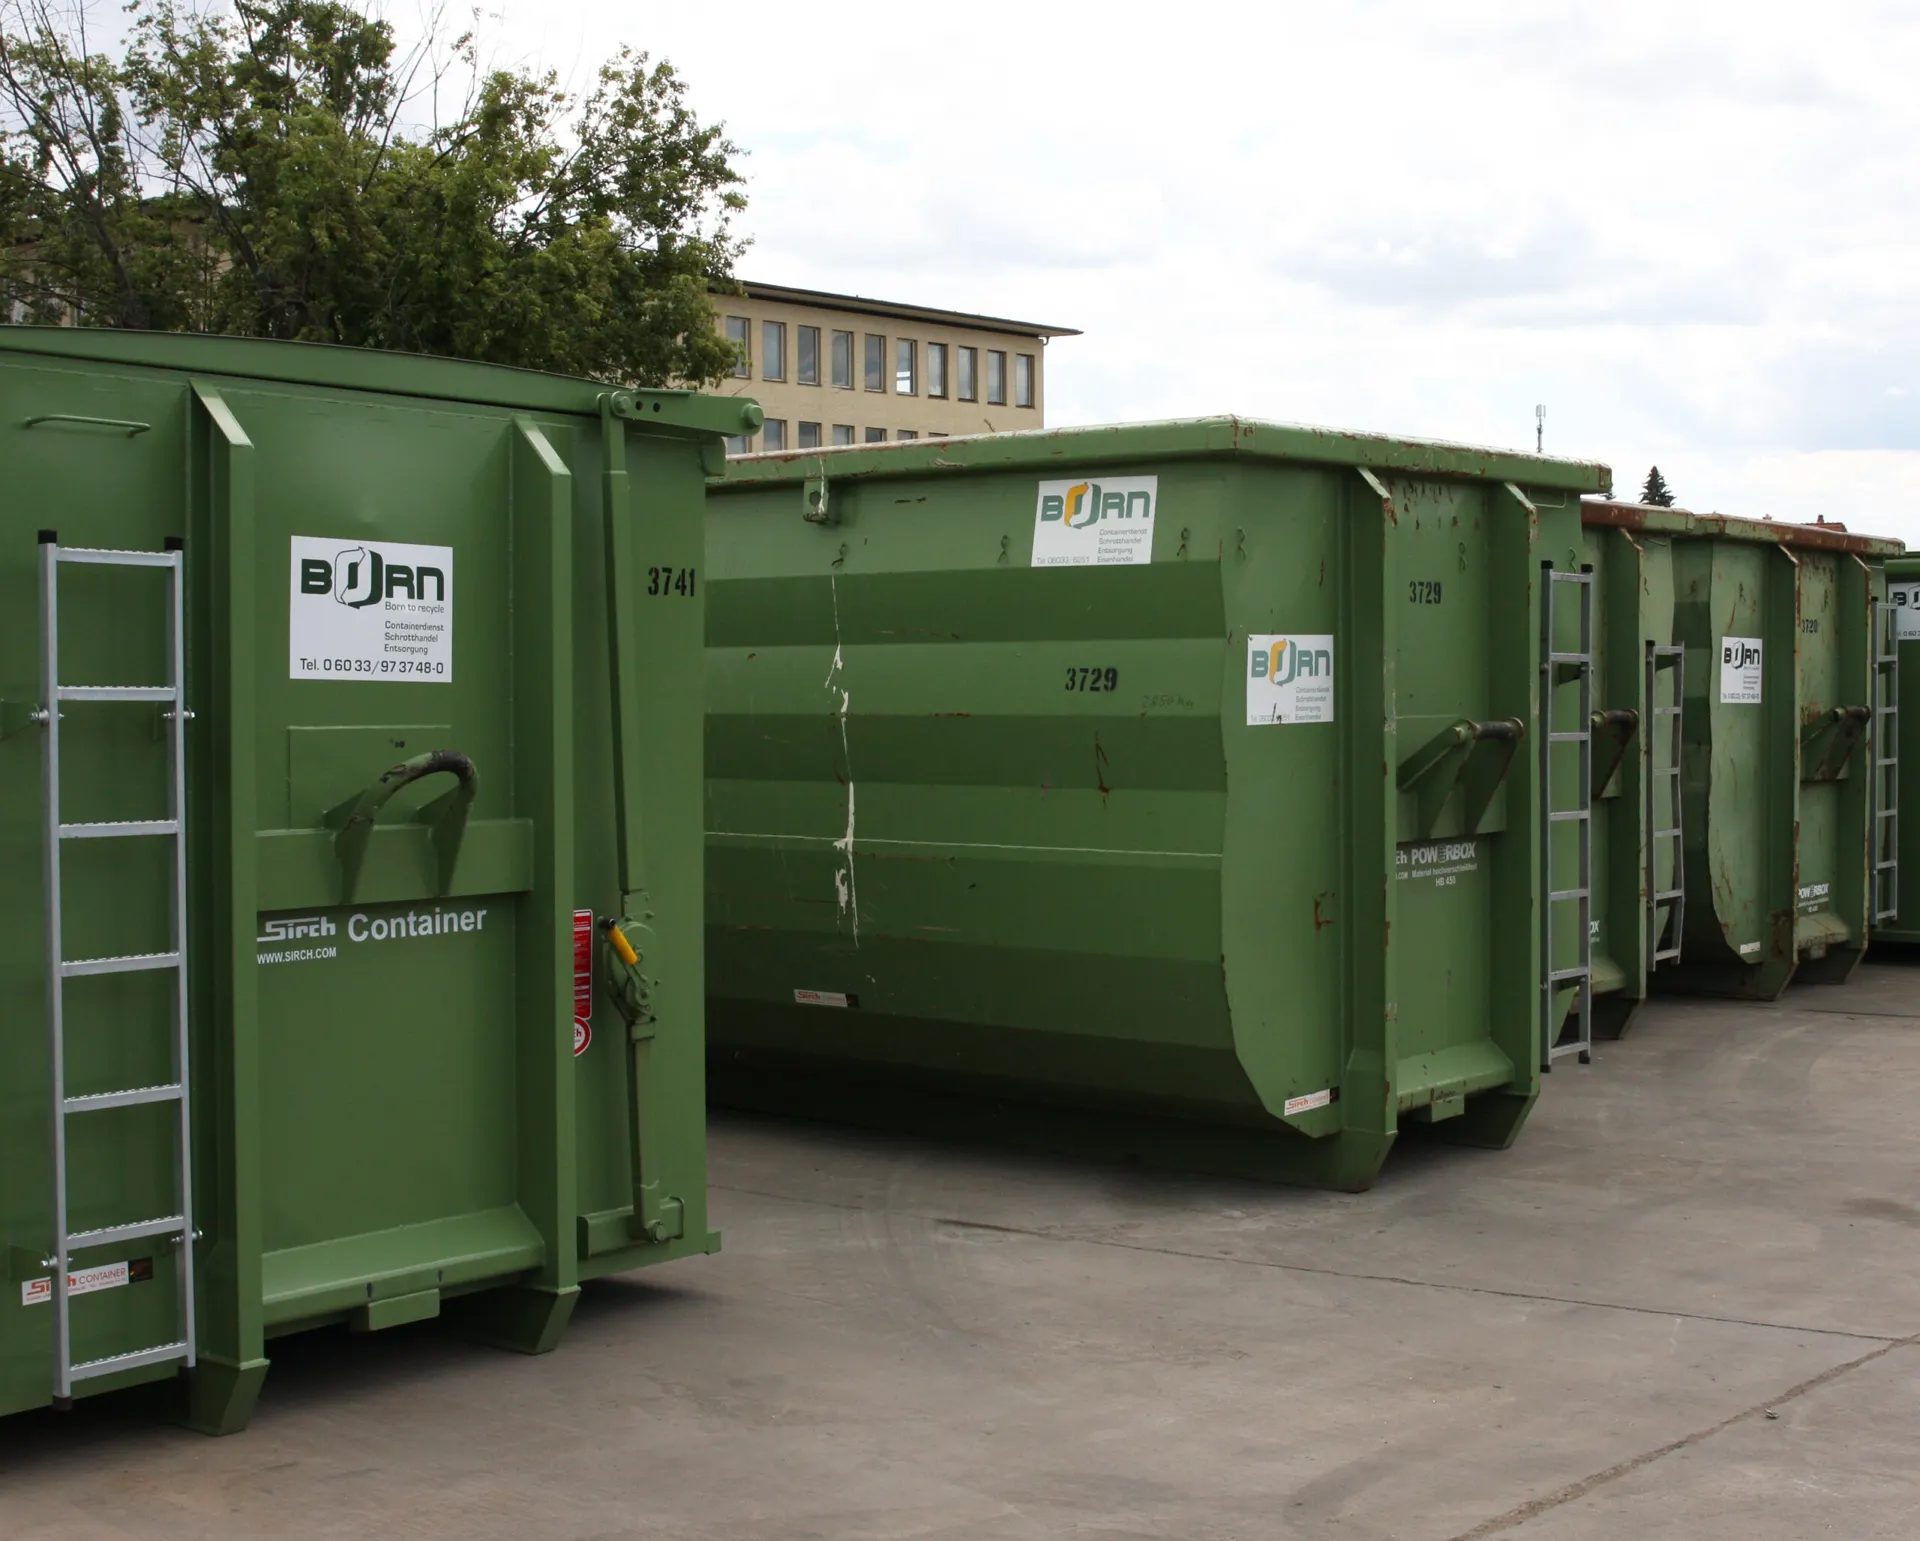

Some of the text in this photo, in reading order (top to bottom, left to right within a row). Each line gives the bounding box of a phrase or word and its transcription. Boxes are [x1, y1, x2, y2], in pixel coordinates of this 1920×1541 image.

[300, 546, 445, 610] BORN
[647, 566, 696, 597] 3741
[1409, 580, 1442, 605] 3729
[385, 601, 445, 615] Born to recycle
[384, 620, 444, 632] Containerdienst
[384, 632, 438, 643] Schrotthandel
[384, 643, 429, 656] Entsorgung
[300, 658, 319, 671] Tel.
[1065, 667, 1118, 692] 3729
[257, 907, 487, 942] Sirch Container
[257, 947, 337, 965] WWW.SIRCH.COM
[79, 1267, 126, 1285] CONTAINER
